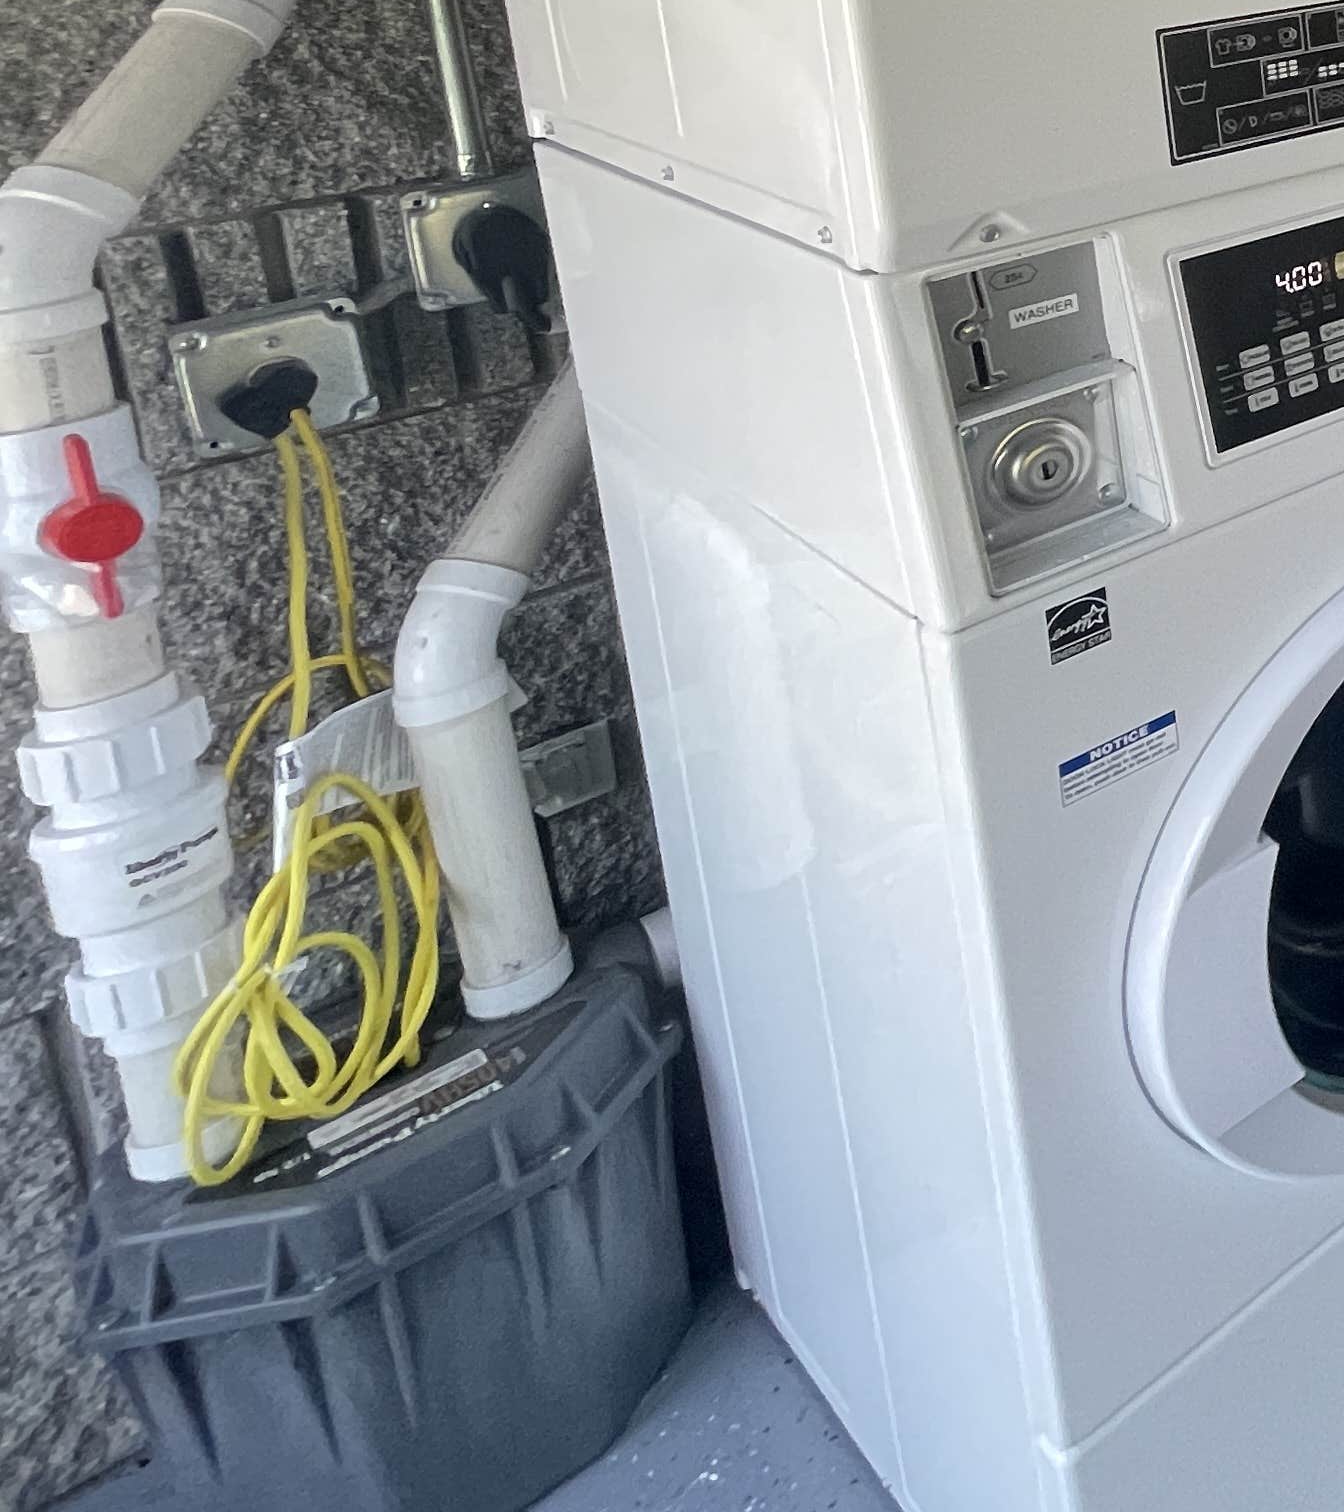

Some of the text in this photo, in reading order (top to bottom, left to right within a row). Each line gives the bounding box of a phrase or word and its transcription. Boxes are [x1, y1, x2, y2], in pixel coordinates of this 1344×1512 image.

[1014, 298, 1074, 323] WASHER
[1051, 629, 1112, 663] ENERGY STAR
[1089, 725, 1149, 762] NOTICE
